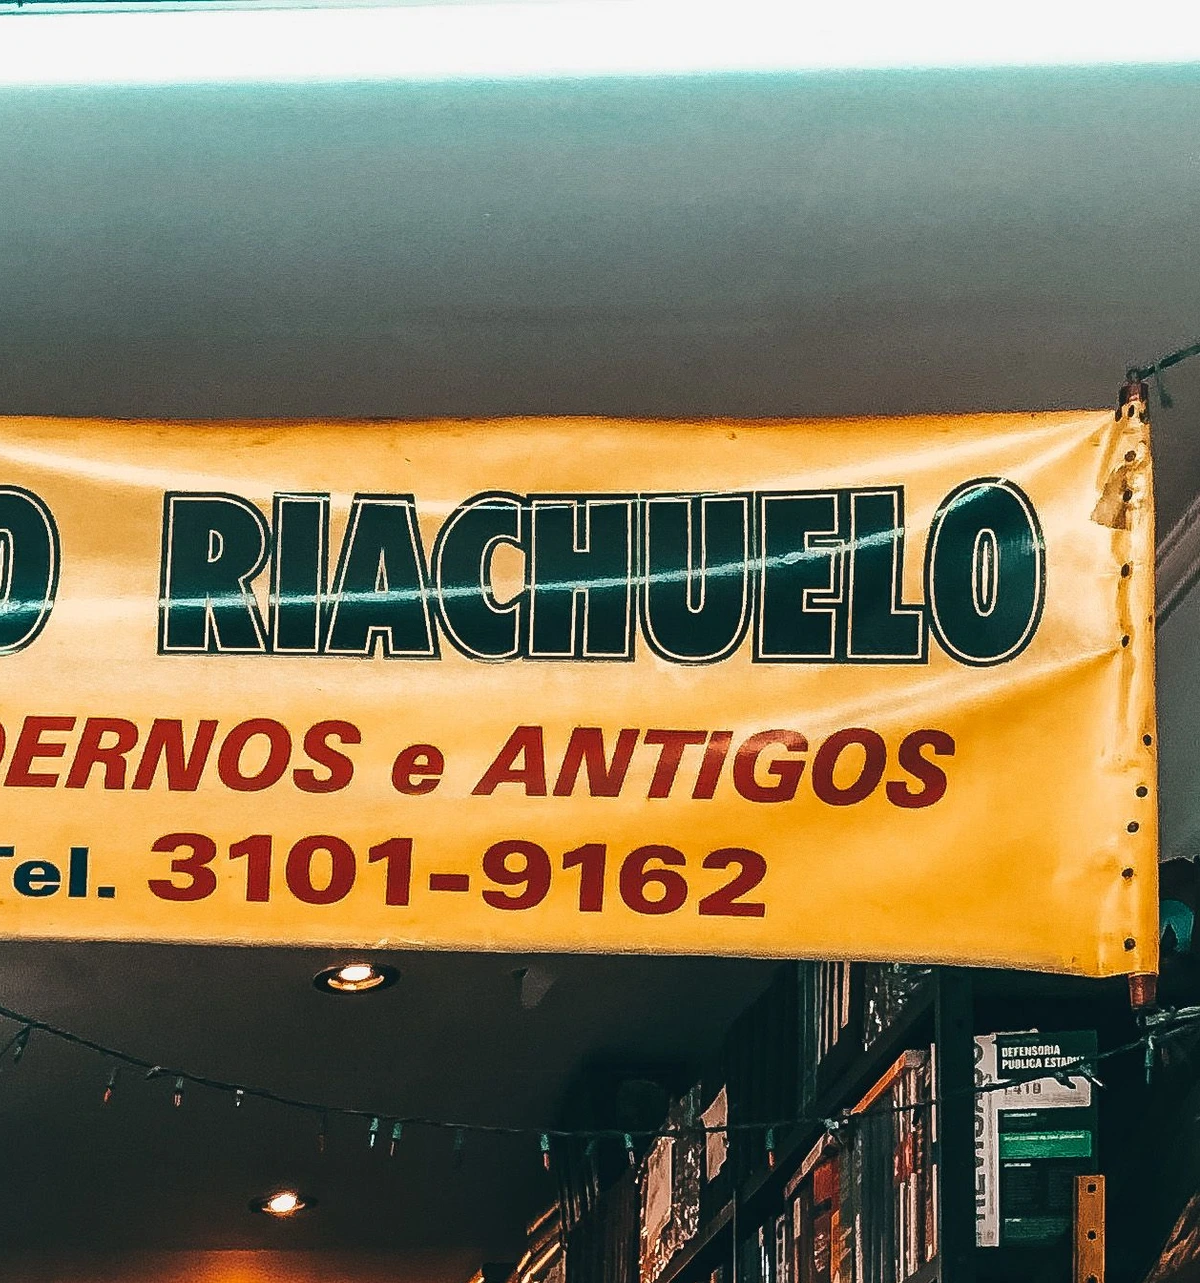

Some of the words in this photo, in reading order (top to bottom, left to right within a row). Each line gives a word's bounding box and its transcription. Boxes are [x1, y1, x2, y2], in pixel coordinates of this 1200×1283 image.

[157, 476, 1046, 668] RIACHUELO
[390, 742, 445, 796] e
[471, 724, 957, 810] ANTIGOS
[148, 832, 768, 918] 3101-9162
